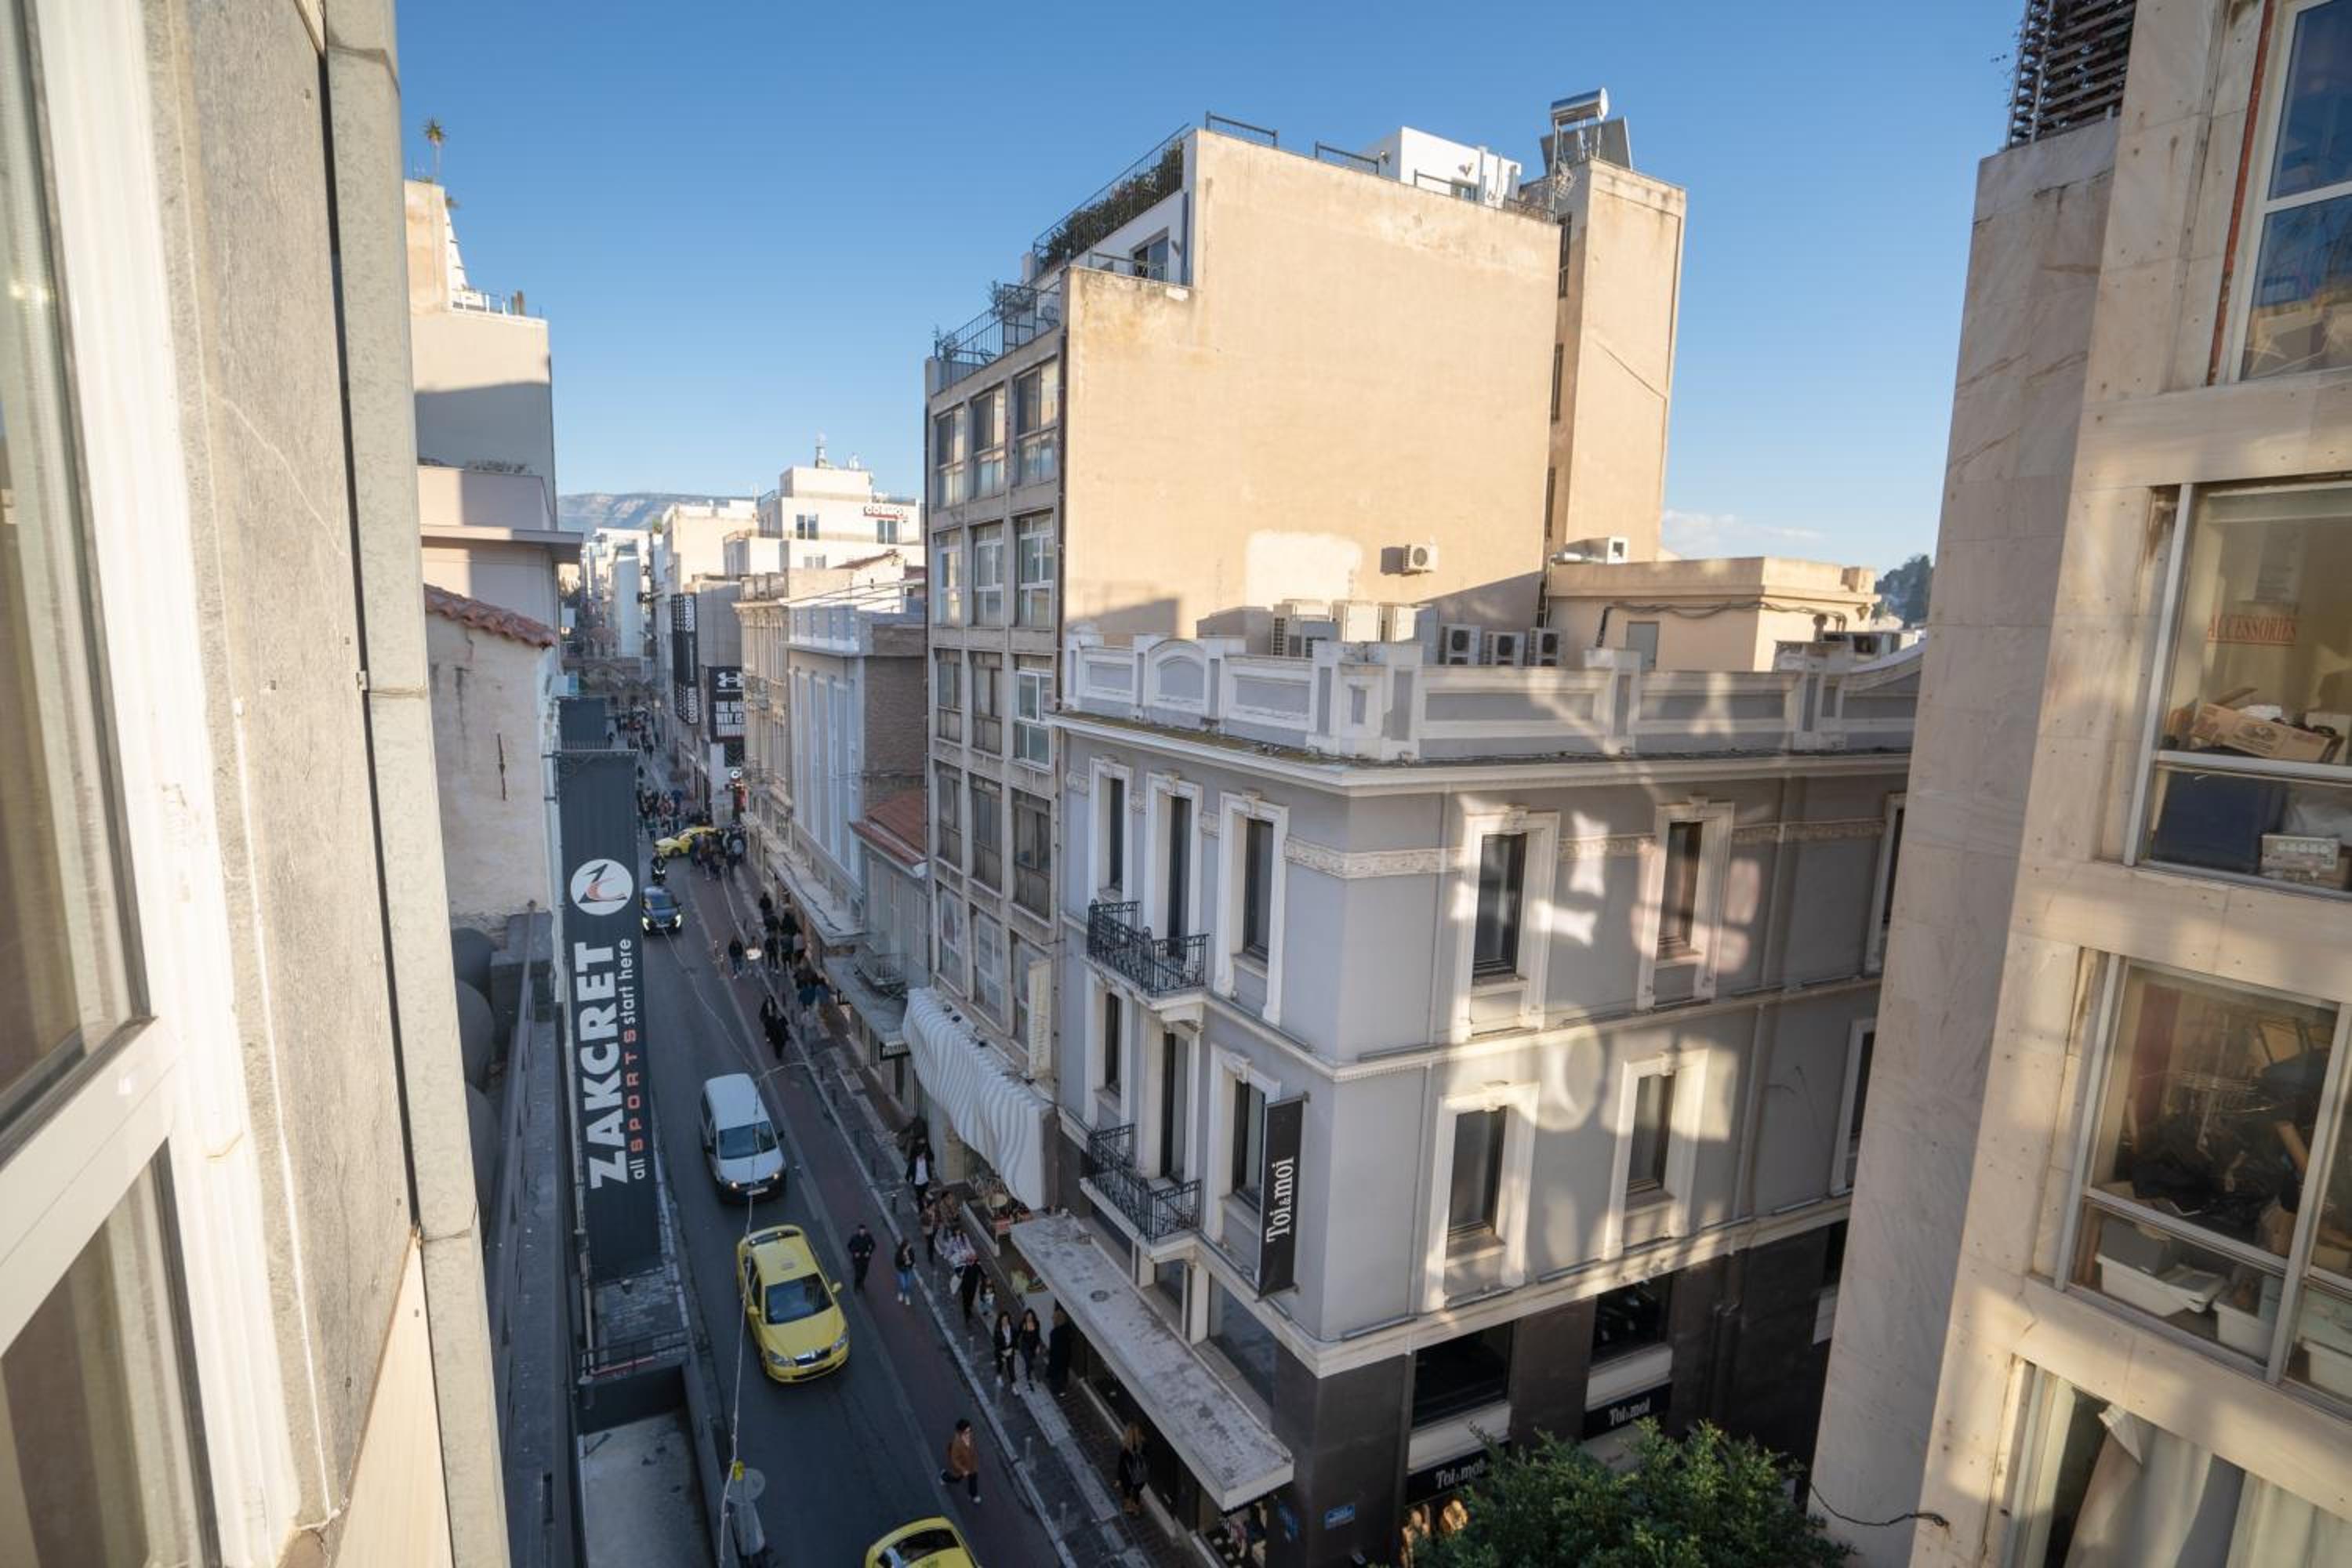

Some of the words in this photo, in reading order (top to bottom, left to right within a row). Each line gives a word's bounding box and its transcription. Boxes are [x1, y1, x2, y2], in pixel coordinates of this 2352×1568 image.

[618, 938, 633, 980] here
[619, 985, 637, 1025] start
[574, 942, 628, 1189] ZAKCRET
[623, 1029, 644, 1152] SPORTS
[630, 1158, 646, 1180] all
